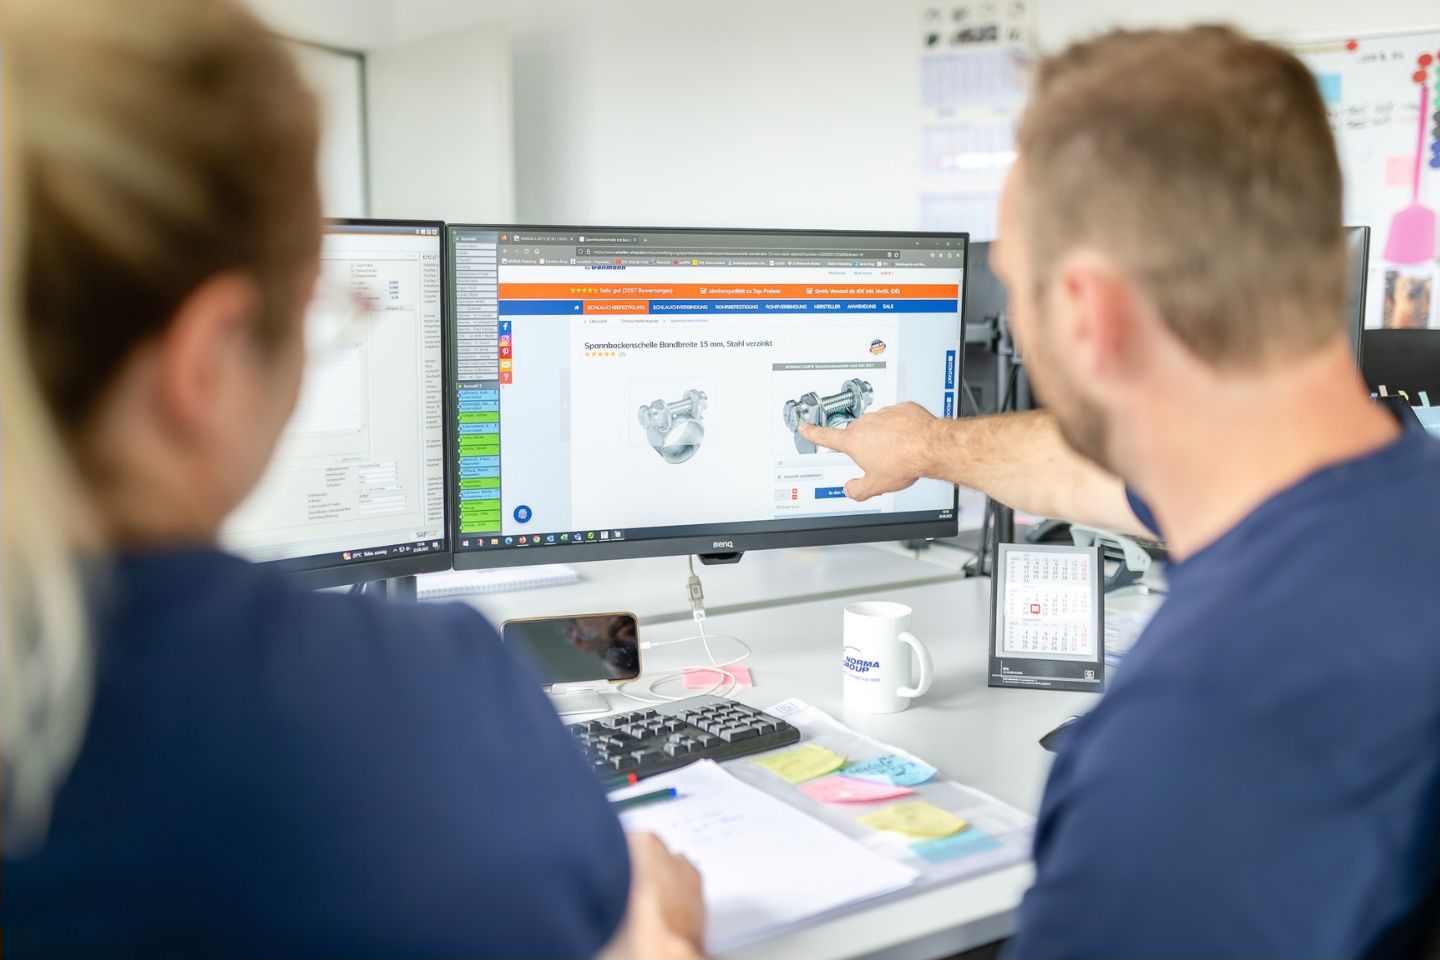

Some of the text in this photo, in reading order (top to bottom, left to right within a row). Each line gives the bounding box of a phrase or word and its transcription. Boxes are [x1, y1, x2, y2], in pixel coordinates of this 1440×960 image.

[584, 341, 658, 350] Spannbackenschelle
[659, 341, 698, 349] Bandbreite
[726, 340, 745, 348] Stahl
[745, 340, 773, 348] verzinkt
[846, 656, 880, 668] NORMA
